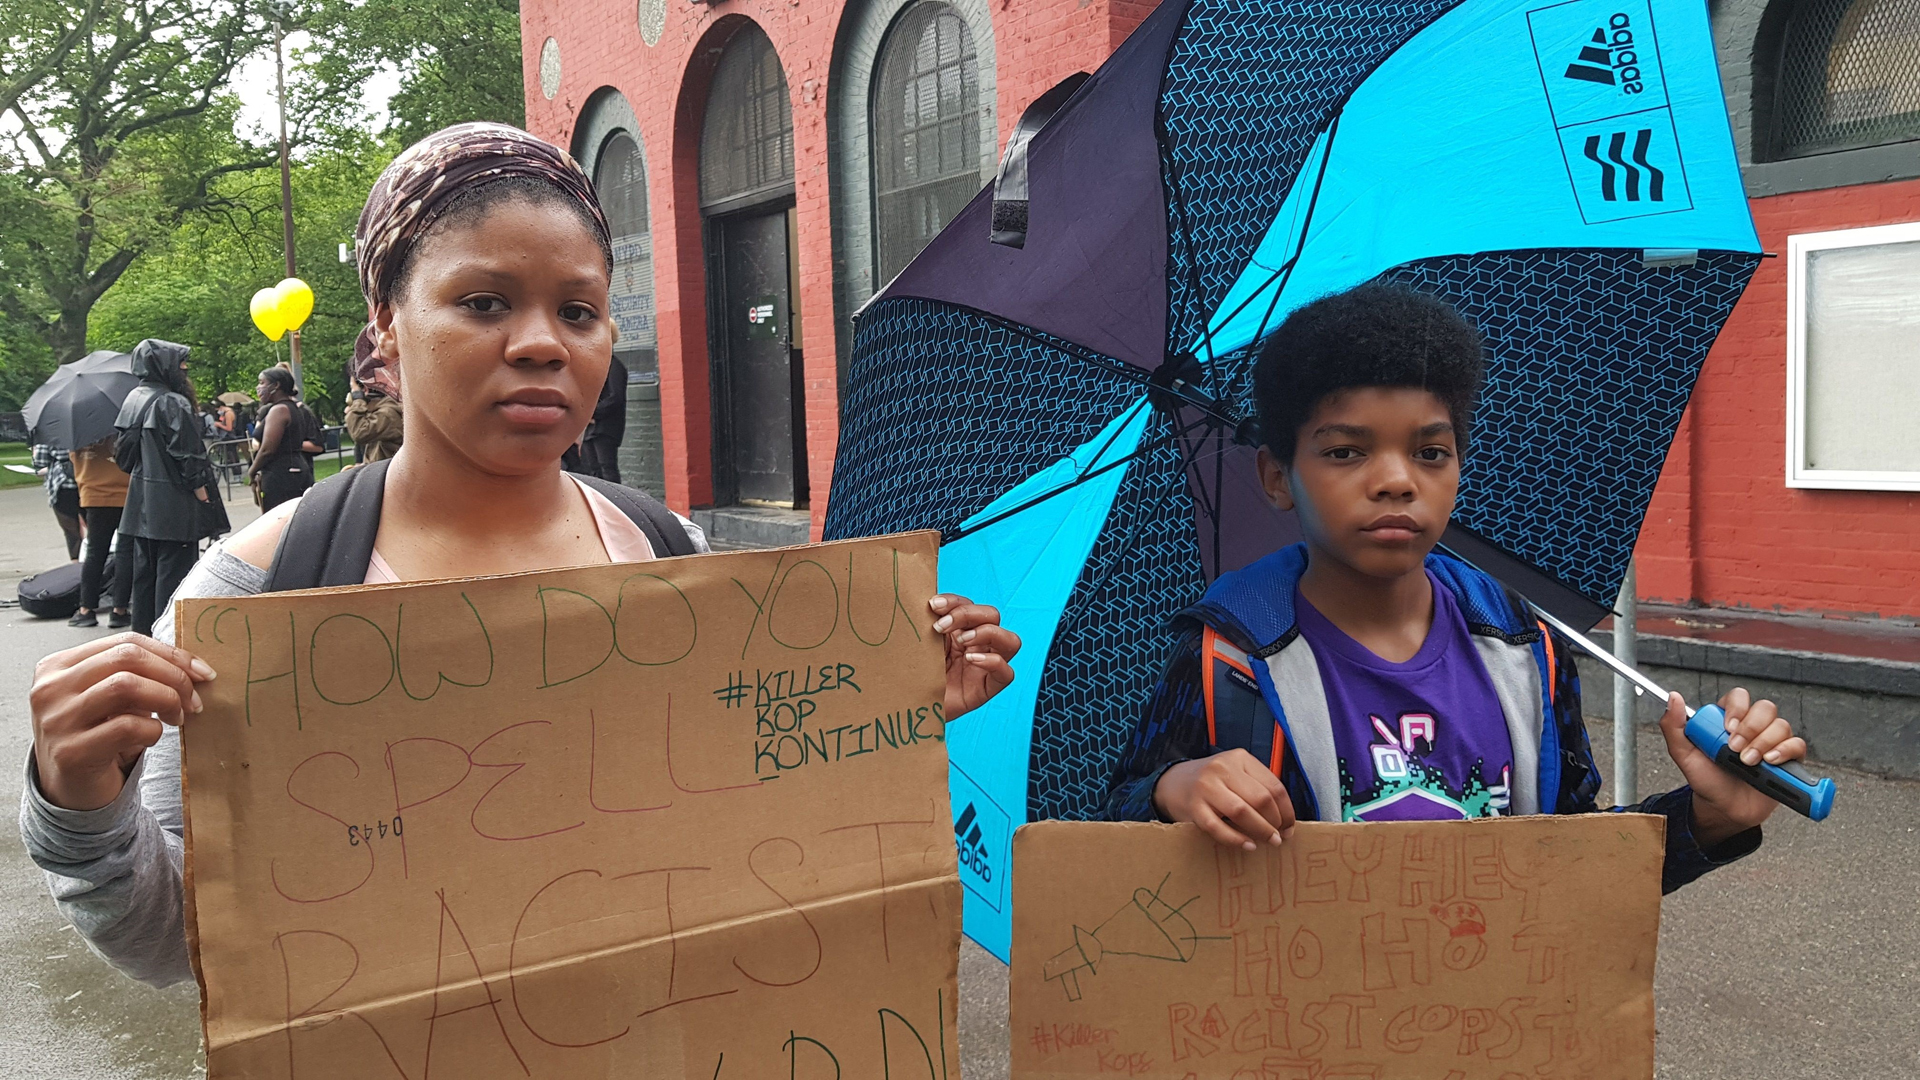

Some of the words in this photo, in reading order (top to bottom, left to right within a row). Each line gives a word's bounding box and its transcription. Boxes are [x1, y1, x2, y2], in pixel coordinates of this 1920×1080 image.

[536, 573, 697, 690] DO
[730, 548, 921, 661] YOU
[713, 662, 862, 708] #KILLER
[755, 699, 817, 738] KOP
[754, 702, 946, 775] KONTINUES
[271, 693, 764, 903] SPELL
[348, 815, 403, 847] 0443
[1214, 834, 1387, 928] HEY
[1399, 833, 1545, 923] HEY
[1232, 926, 1323, 997] HO
[1361, 912, 1487, 991] HO
